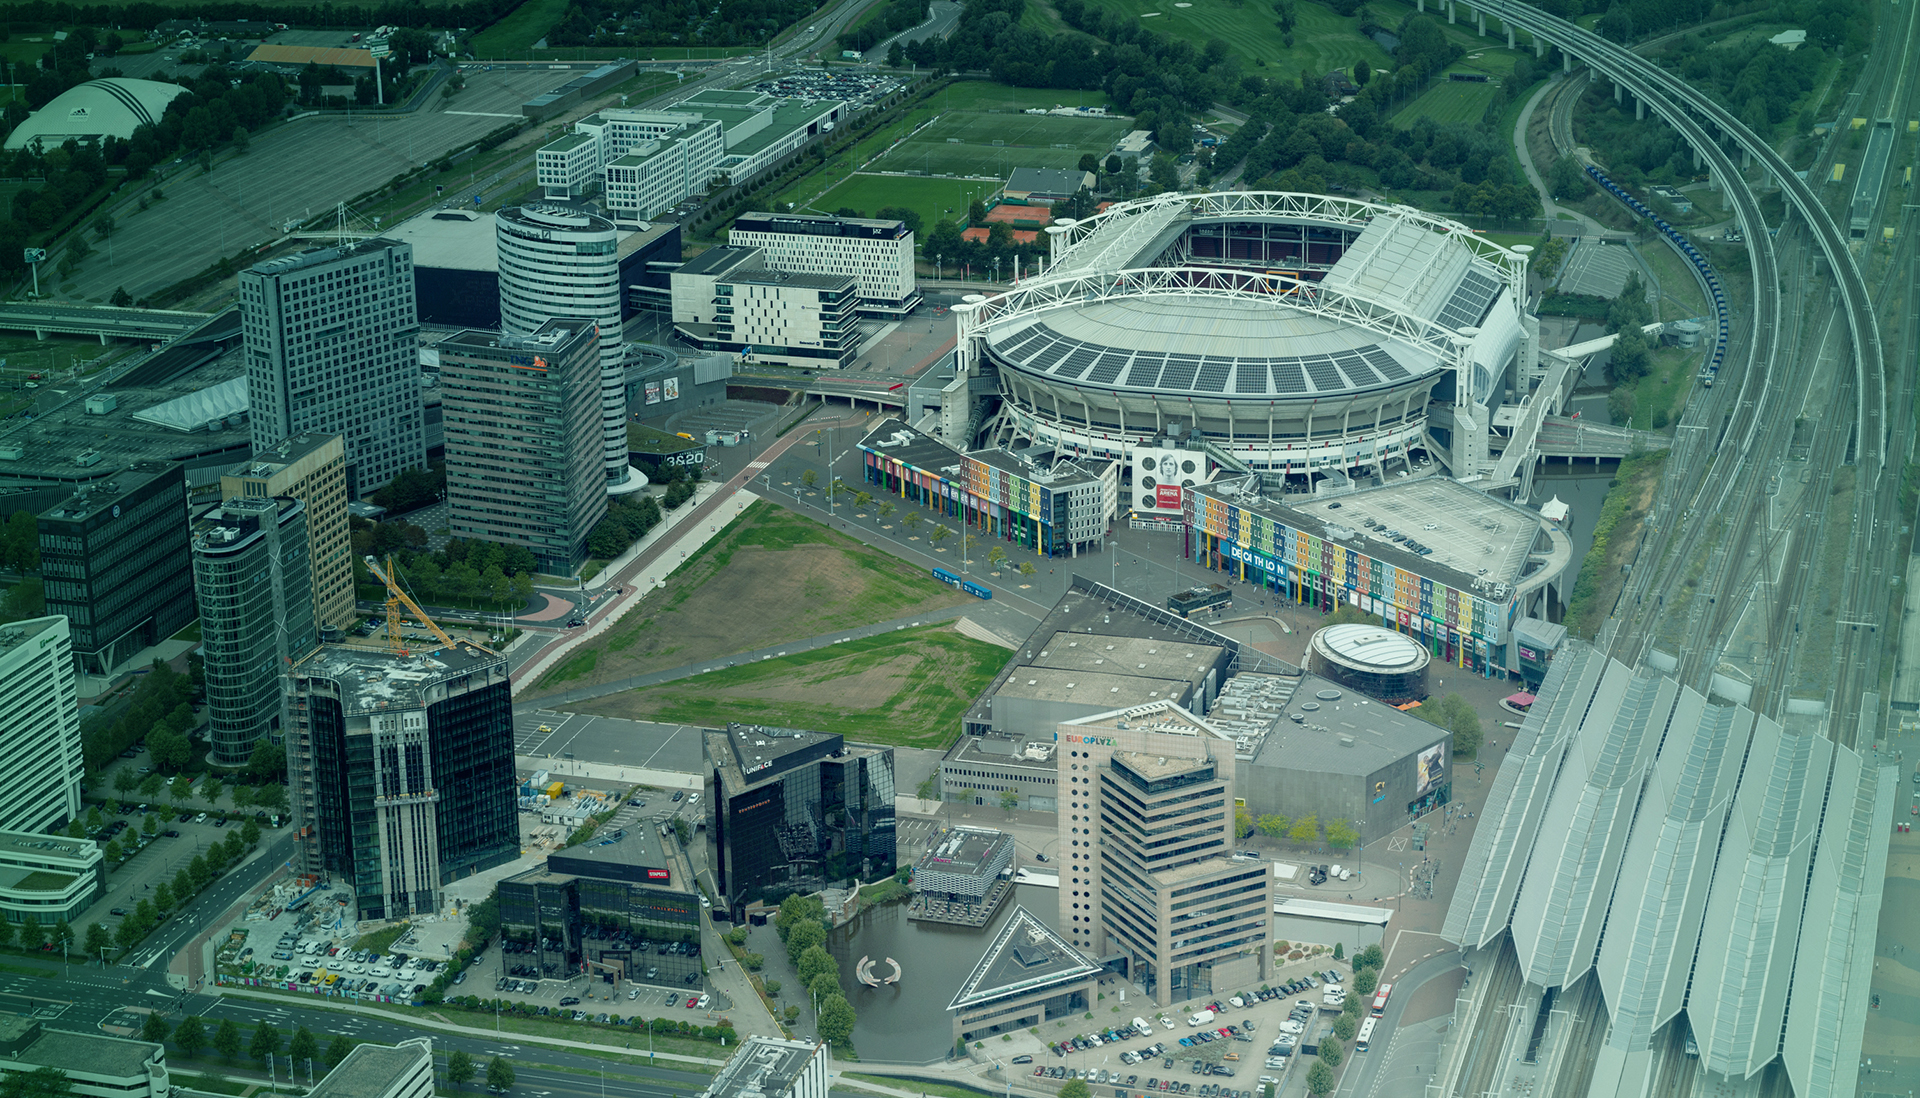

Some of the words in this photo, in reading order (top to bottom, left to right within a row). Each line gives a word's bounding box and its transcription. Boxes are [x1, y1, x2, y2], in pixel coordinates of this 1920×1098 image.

[527, 230, 540, 238] Bank
[510, 354, 532, 366] ING
[666, 452, 704, 467] 3&20
[877, 456, 919, 485] PERRY
[1231, 546, 1284, 576] DECATHLON
[1066, 734, 1118, 747] EUROPLAZA
[746, 760, 773, 775] UNIFACE
